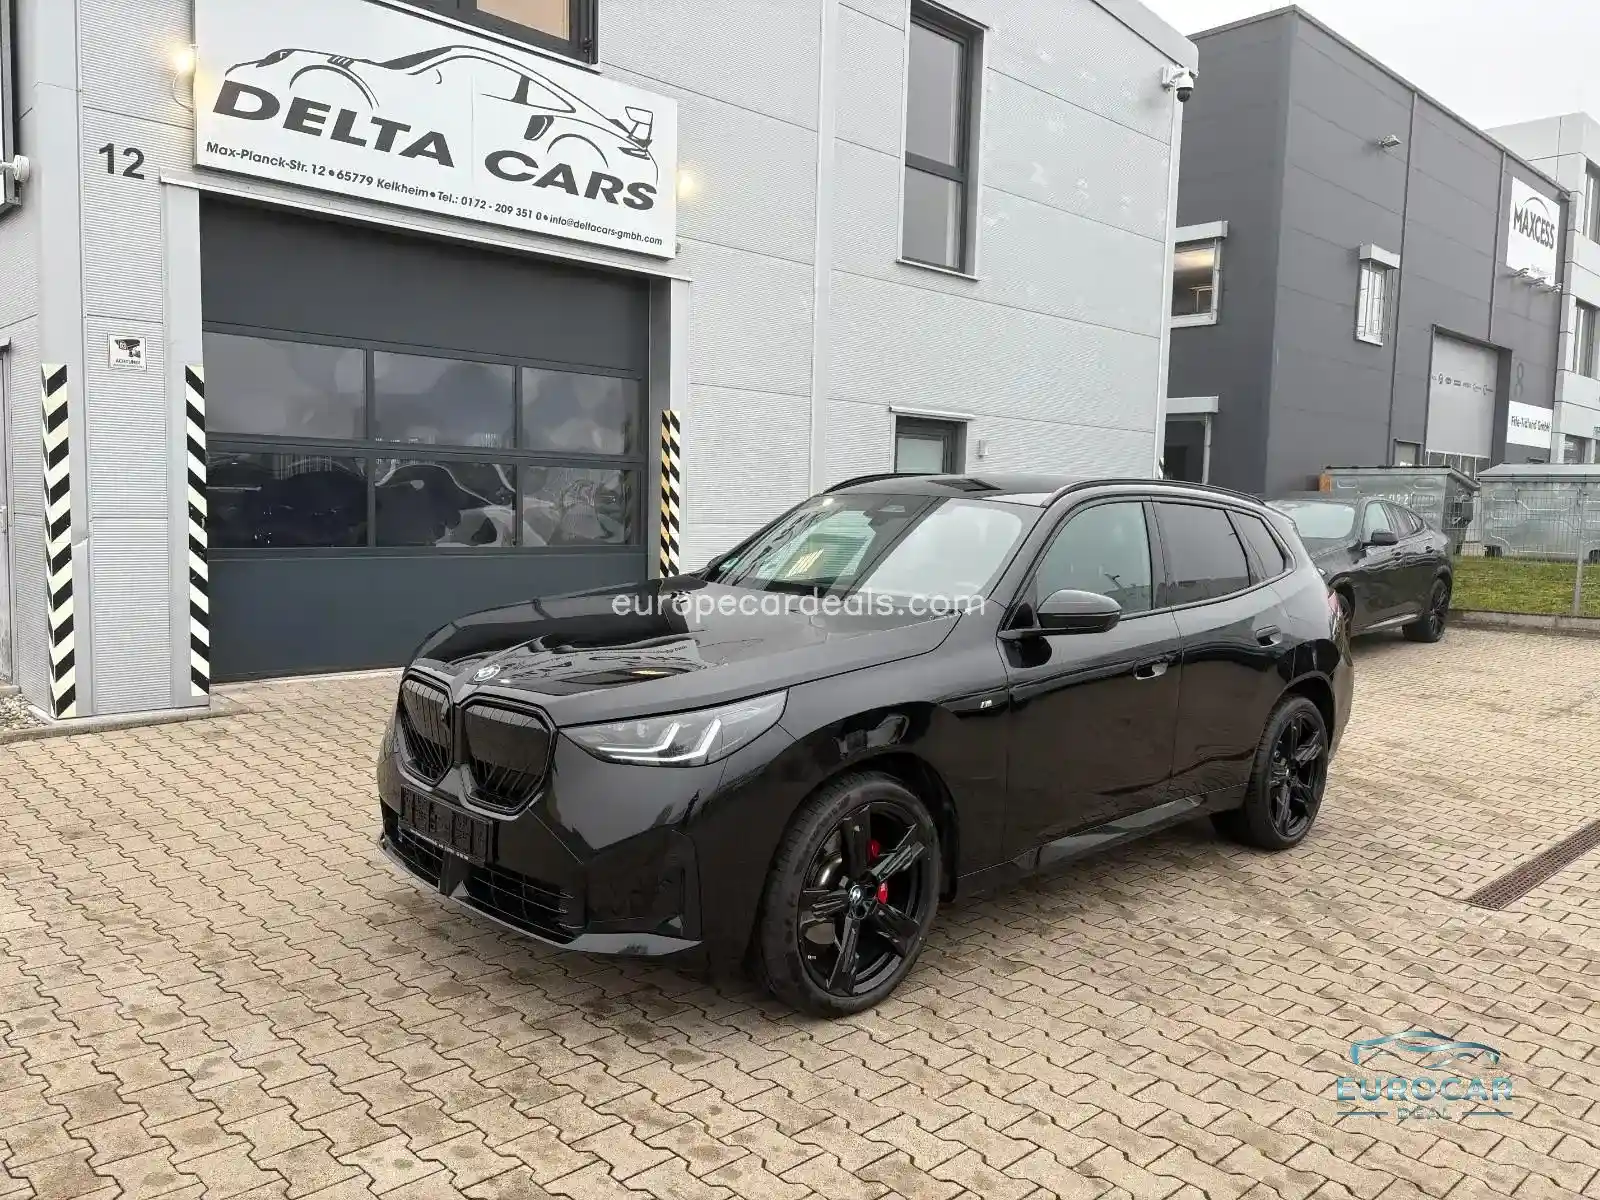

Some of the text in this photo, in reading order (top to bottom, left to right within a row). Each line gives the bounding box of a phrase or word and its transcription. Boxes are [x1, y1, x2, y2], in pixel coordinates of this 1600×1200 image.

[98, 142, 145, 180] 12
[212, 79, 657, 211] DELTA CARS
[206, 141, 308, 173] Max-Planck-Str.
[311, 163, 326, 176] 12
[336, 169, 374, 186] 65779
[376, 178, 429, 198] Kelkheim
[438, 191, 459, 204] Tel.:
[461, 196, 487, 210] 0172
[494, 203, 514, 215] 209
[515, 207, 534, 219] 351
[535, 211, 542, 221] 0
[549, 214, 663, 246] info@deltacars-gmbh.com
[1513, 201, 1556, 250] MAXCESS
